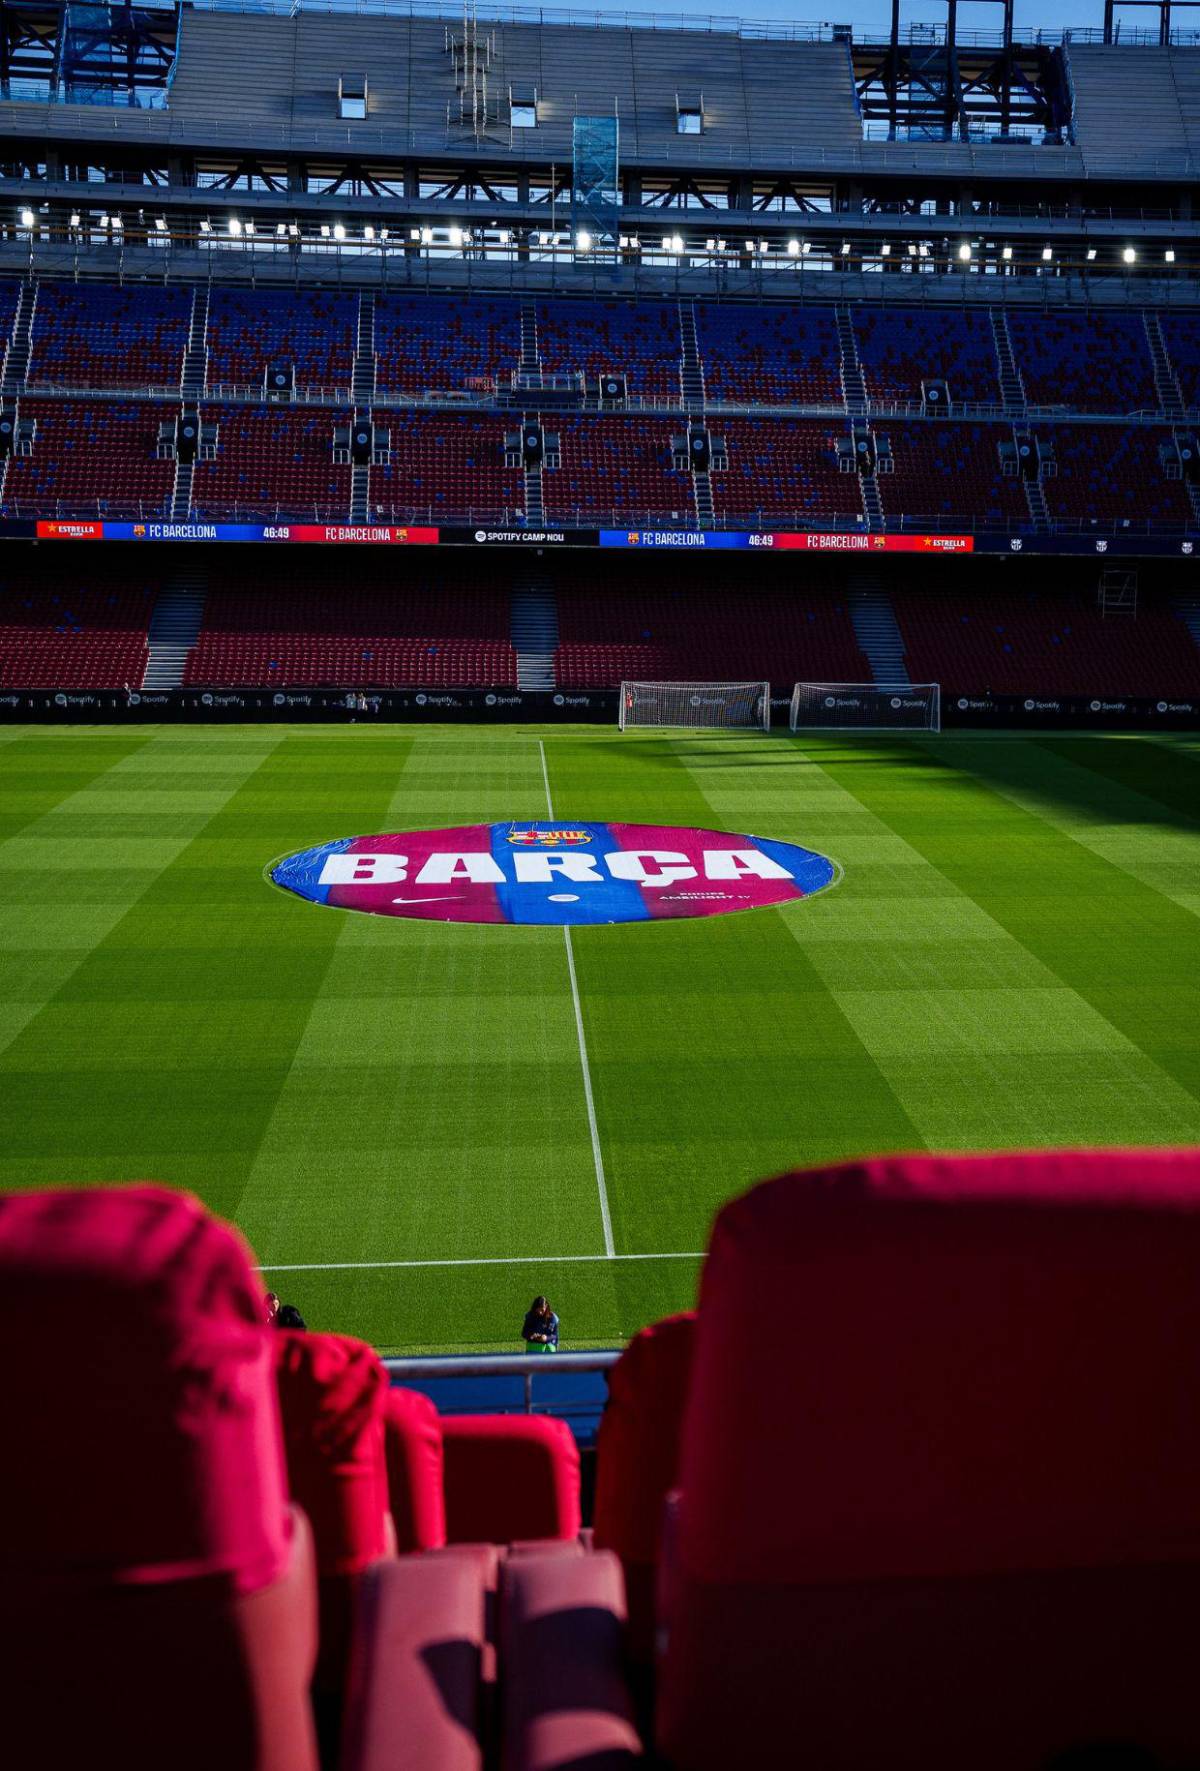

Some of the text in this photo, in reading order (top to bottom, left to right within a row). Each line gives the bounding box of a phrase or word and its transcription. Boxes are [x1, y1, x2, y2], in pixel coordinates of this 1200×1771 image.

[58, 525, 95, 533] ESTRELLA
[150, 524, 217, 538] FC BARCELONA
[263, 526, 290, 539] 46:49
[325, 527, 391, 541] FC BARCELONA
[487, 532, 565, 542] SPOTIFY CAMP NOU
[642, 532, 706, 546] FC BARCELONA
[748, 534, 774, 547] 46:49
[807, 535, 869, 549] FC BARCELONA
[932, 538, 966, 547] ESTRELLA
[316, 849, 795, 887] BARÇA
